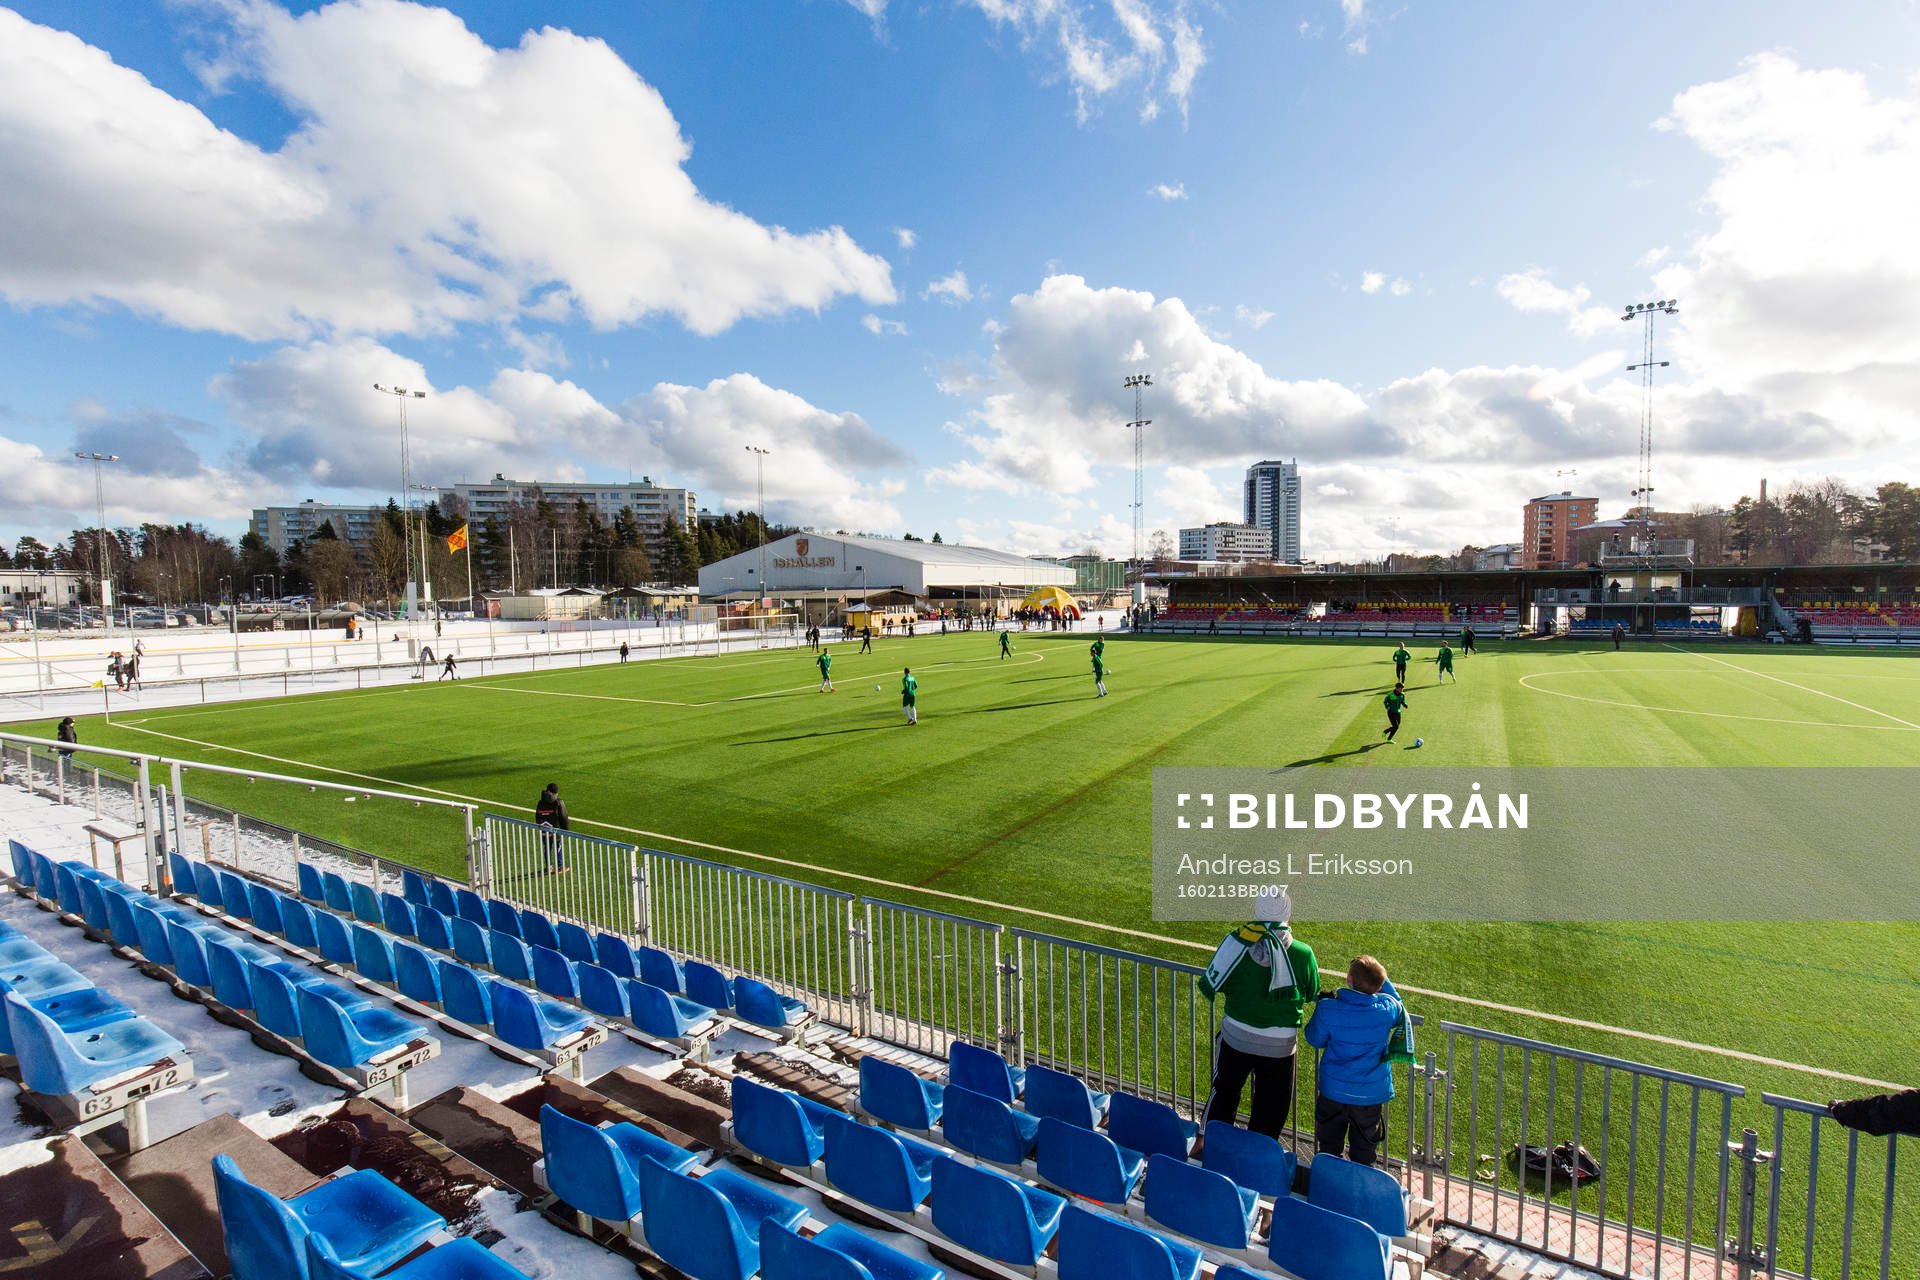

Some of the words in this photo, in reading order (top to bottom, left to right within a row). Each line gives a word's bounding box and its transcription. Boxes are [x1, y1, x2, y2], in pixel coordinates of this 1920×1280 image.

[773, 557, 835, 569] ISHALLEN
[368, 1068, 388, 1085] 63
[413, 1049, 431, 1066] 72
[557, 1053, 571, 1066] 63
[588, 1034, 601, 1047] 72
[84, 1095, 113, 1115] 63
[151, 1069, 178, 1092] 72
